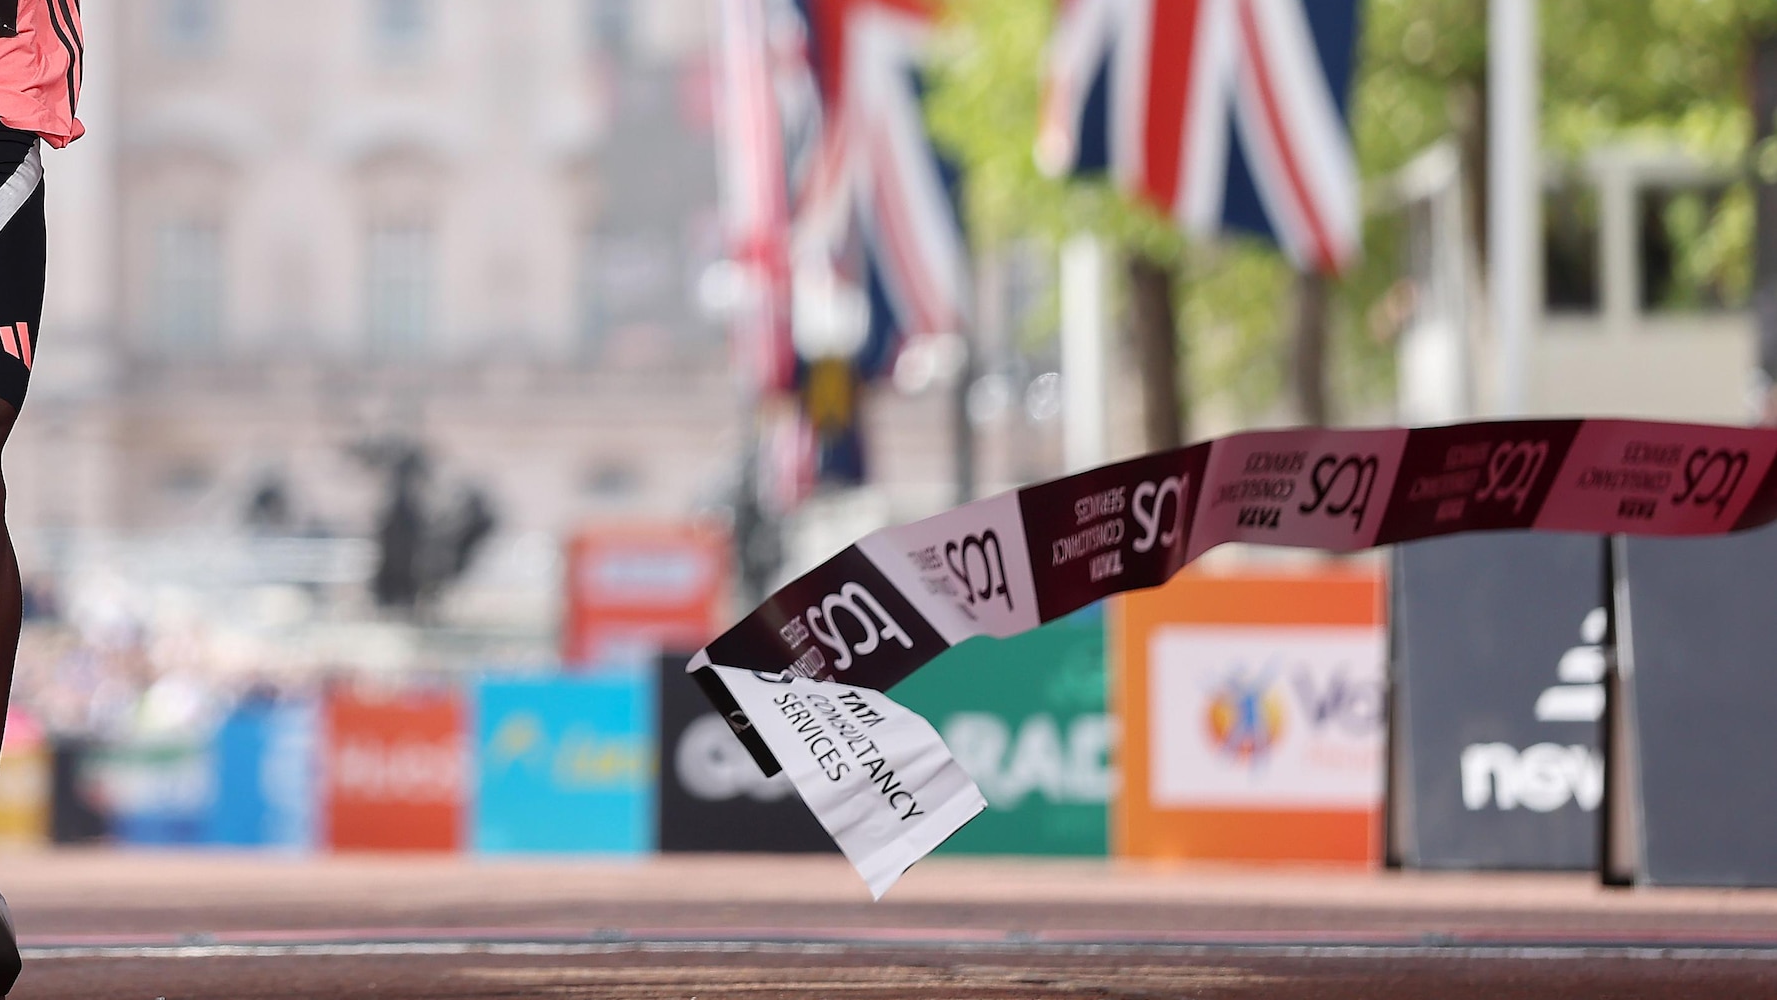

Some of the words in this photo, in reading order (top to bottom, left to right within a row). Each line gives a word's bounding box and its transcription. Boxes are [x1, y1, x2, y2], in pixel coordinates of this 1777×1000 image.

[1130, 472, 1190, 553] cs
[1237, 506, 1281, 531] TATA
[1297, 453, 1379, 533] tcs
[1672, 446, 1749, 520] tcs
[945, 528, 1015, 613] tcs
[806, 582, 914, 671] tcs
[773, 691, 851, 784] SERVICES
[837, 690, 886, 729] TATA
[806, 692, 924, 822] CONSULTANCY
